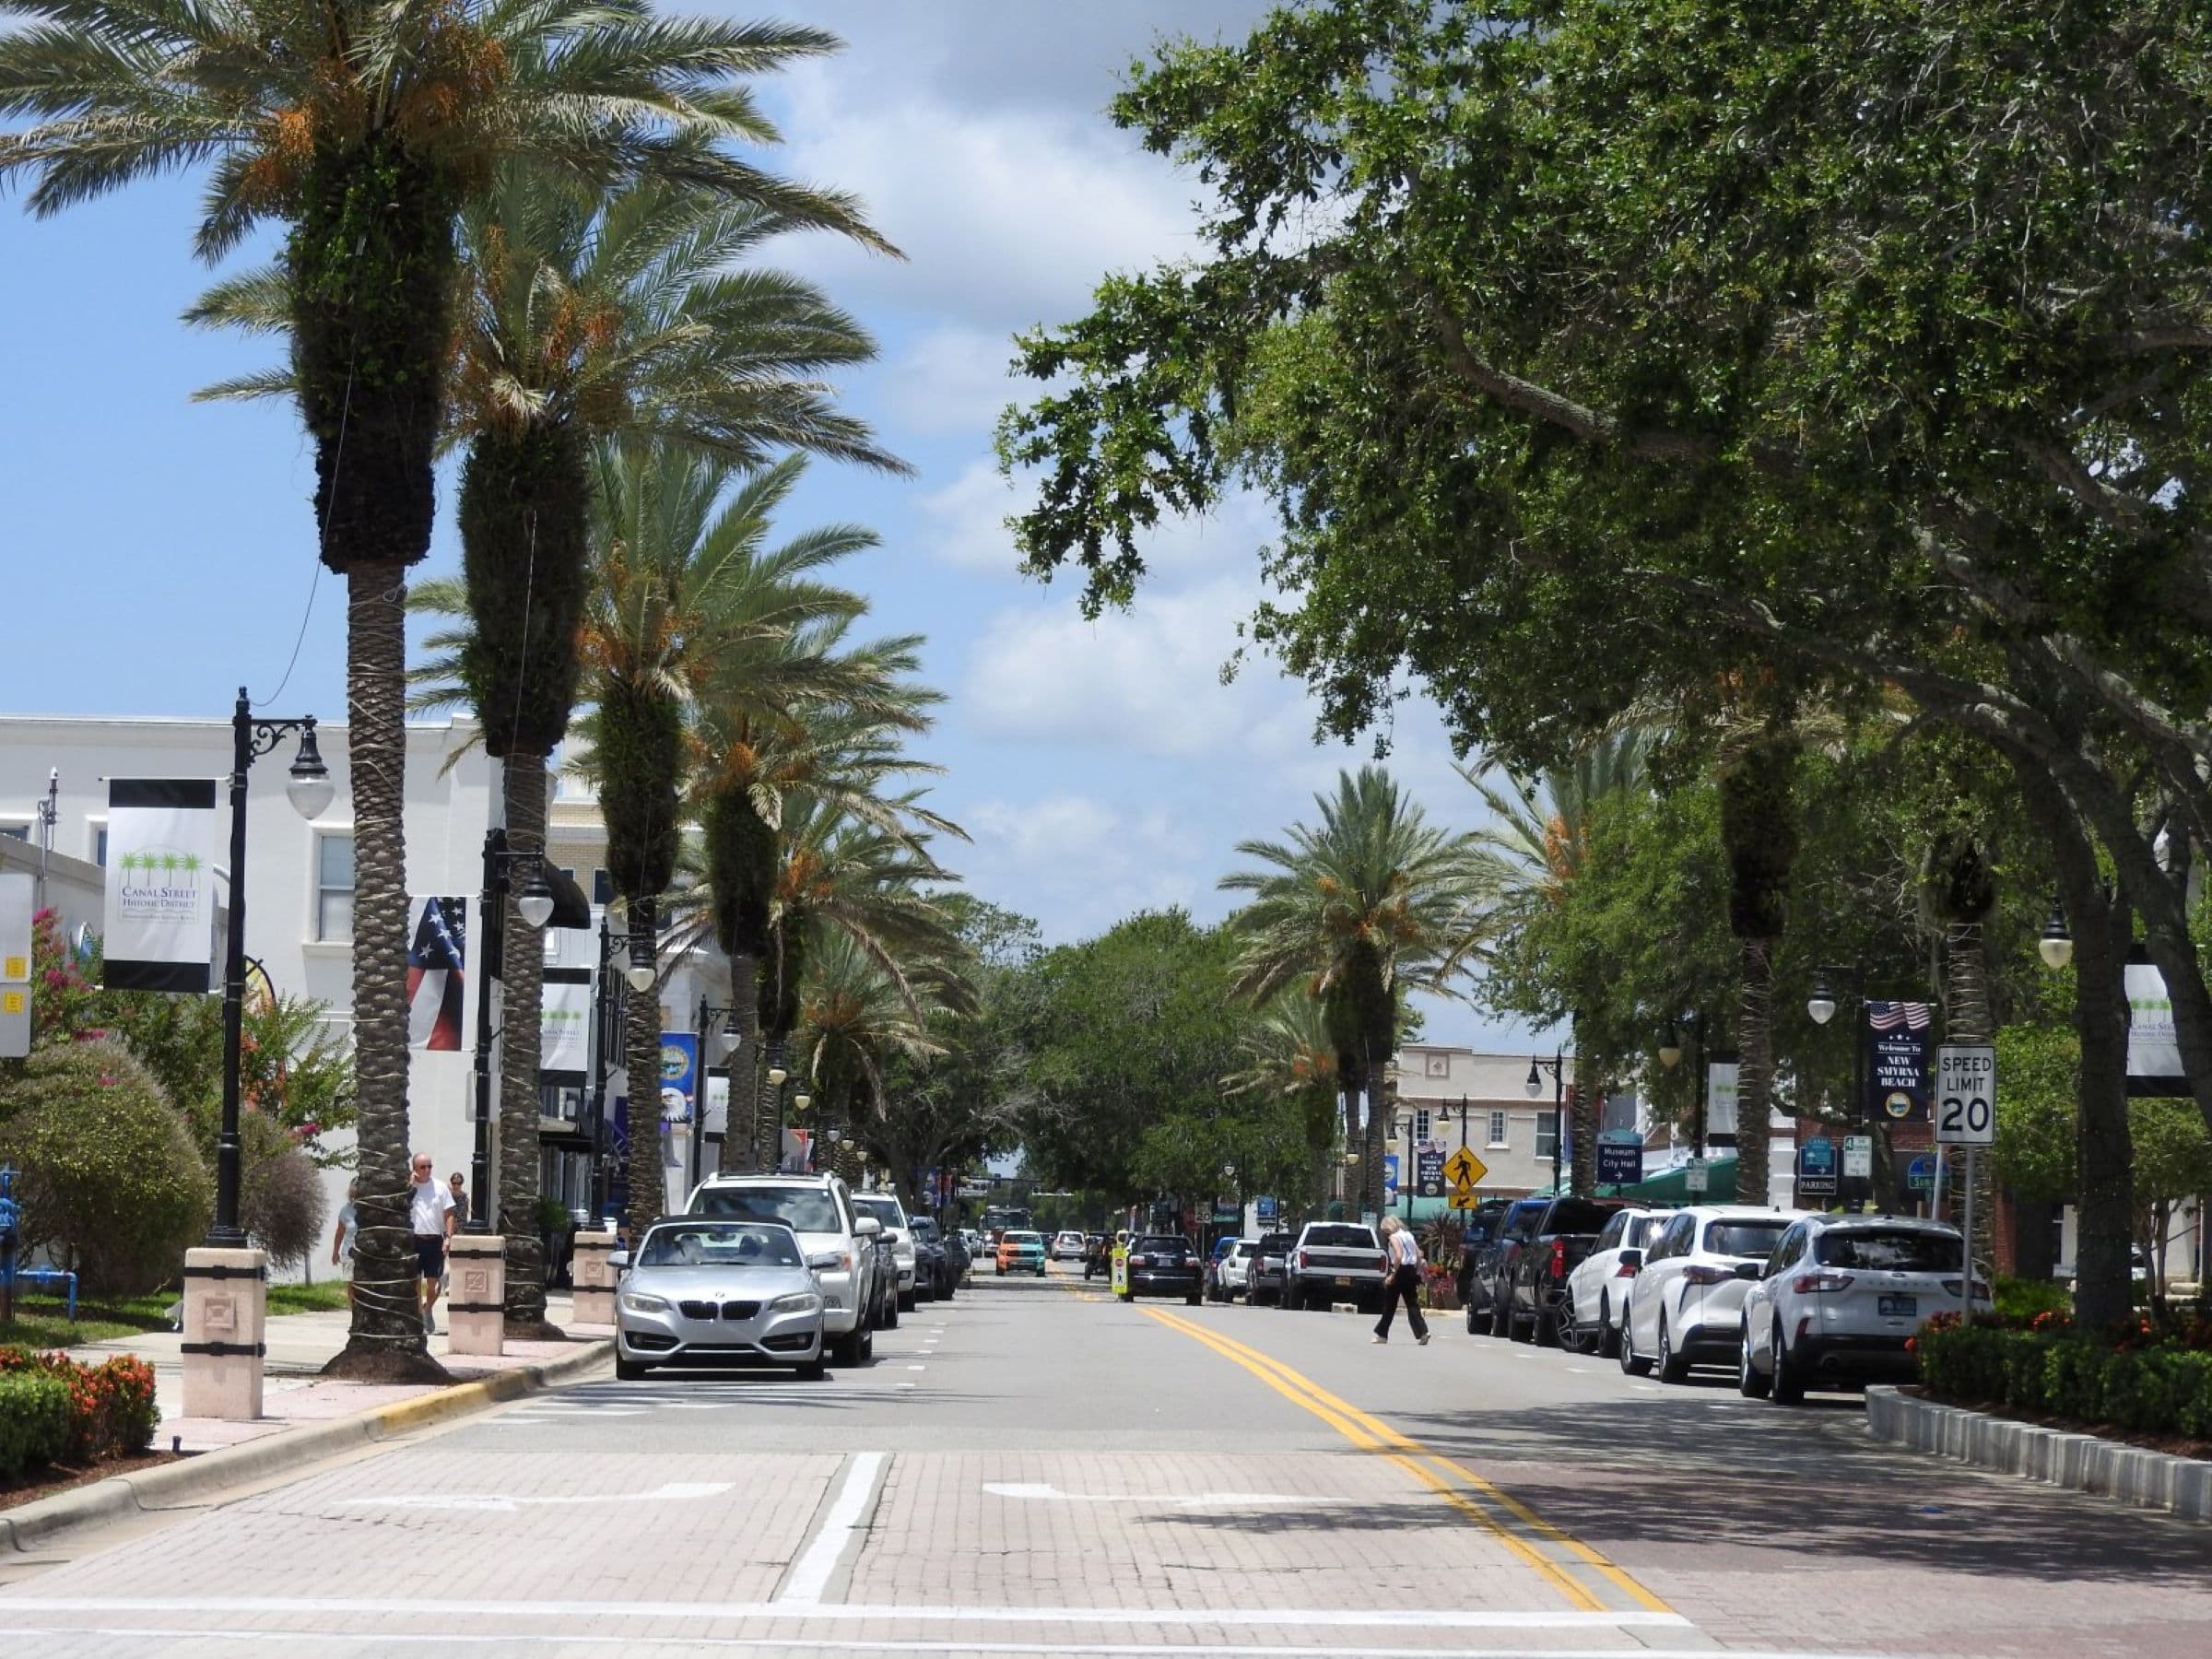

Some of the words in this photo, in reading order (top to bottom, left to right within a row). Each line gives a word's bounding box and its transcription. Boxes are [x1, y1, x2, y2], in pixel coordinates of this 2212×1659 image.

[1877, 1043, 1911, 1052] Welcome
[1887, 1055, 1910, 1065] NEW
[1942, 1056, 1992, 1072] SPEED
[1877, 1066, 1920, 1077] SMYRNA
[1880, 1077, 1915, 1088] BEACH
[1947, 1077, 1985, 1092] LIMIT
[1941, 1097, 1990, 1133] 20
[1604, 1147, 1636, 1156] Museum
[1603, 1159, 1618, 1169] City
[1620, 1159, 1636, 1168] Hall
[1800, 1181, 1834, 1190] PARKING
